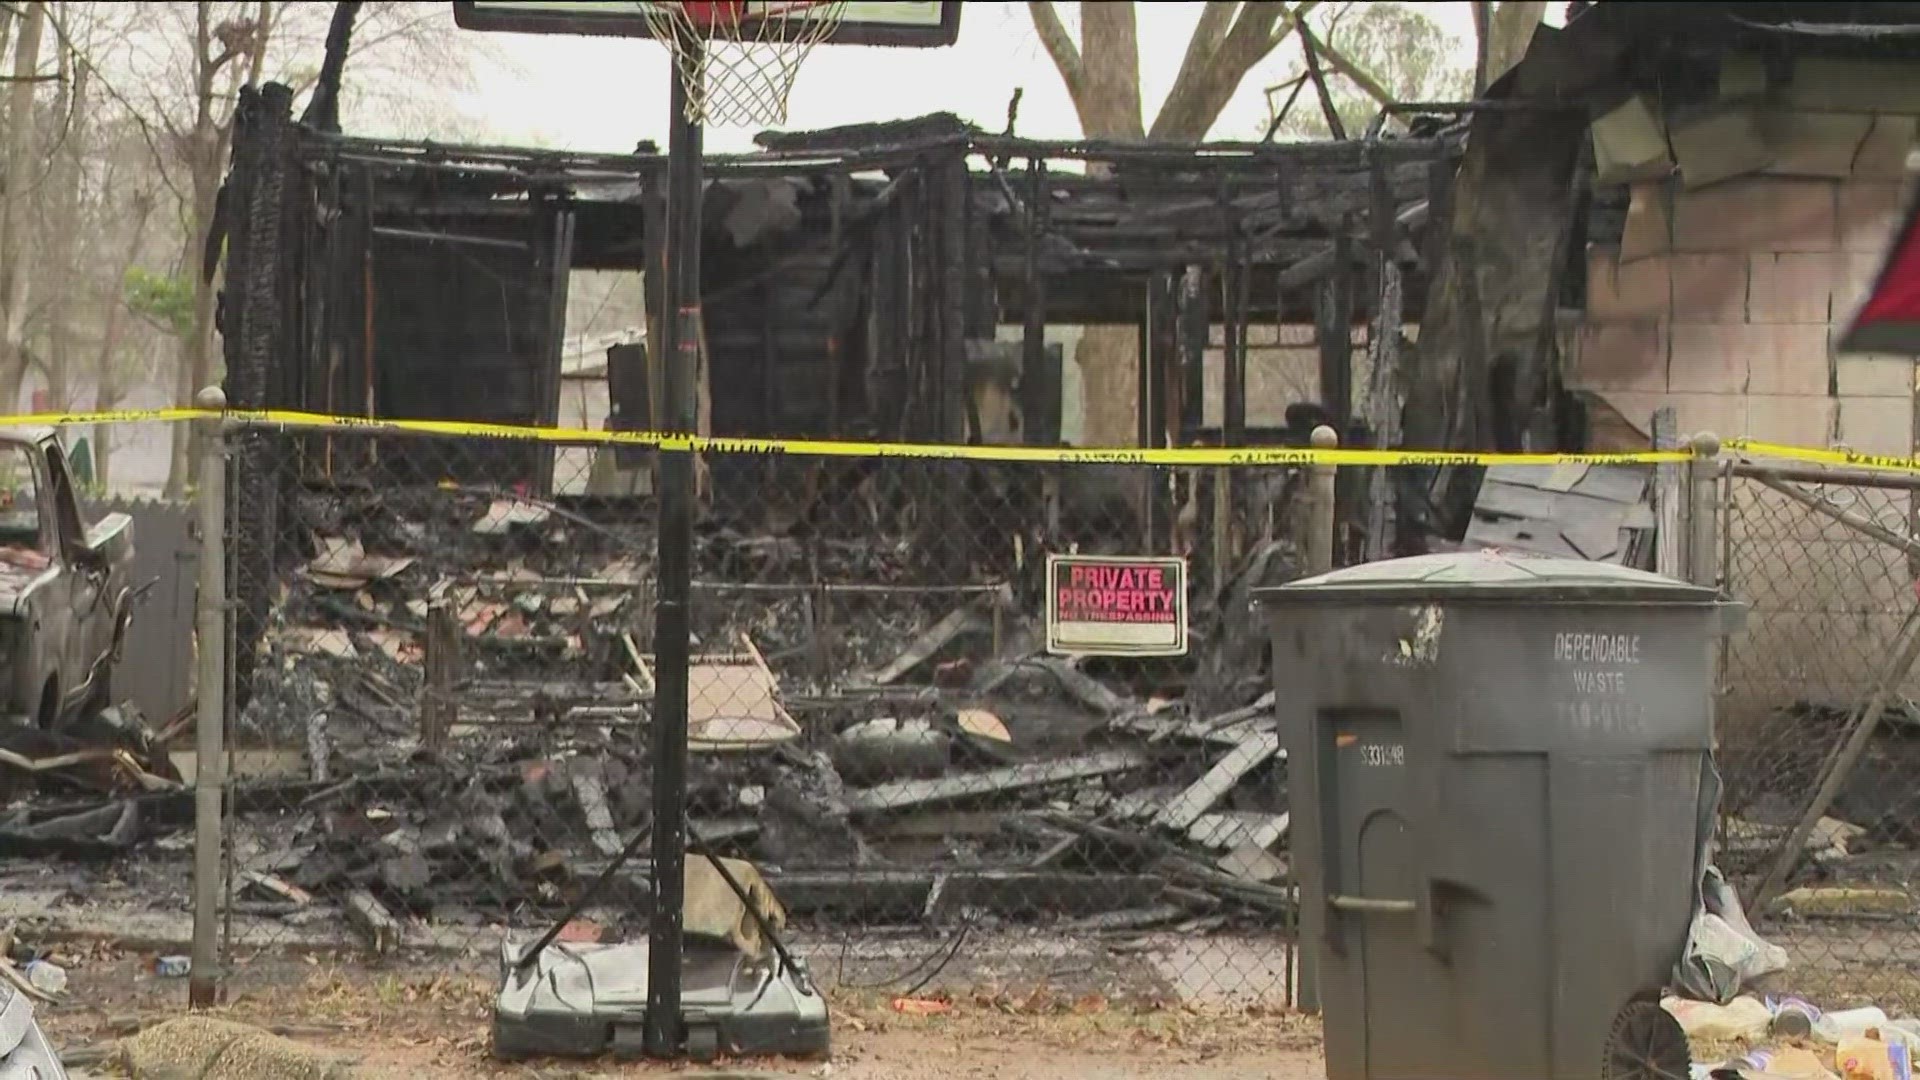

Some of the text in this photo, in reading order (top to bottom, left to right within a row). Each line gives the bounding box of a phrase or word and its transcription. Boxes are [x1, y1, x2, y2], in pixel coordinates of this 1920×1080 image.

[1229, 453, 1316, 465] CAUTION
[1070, 566, 1162, 589] PRIVATE
[1059, 588, 1174, 611] PROPERTY
[1554, 632, 1641, 665] DEPENDABLE
[1573, 669, 1626, 694] WASTE
